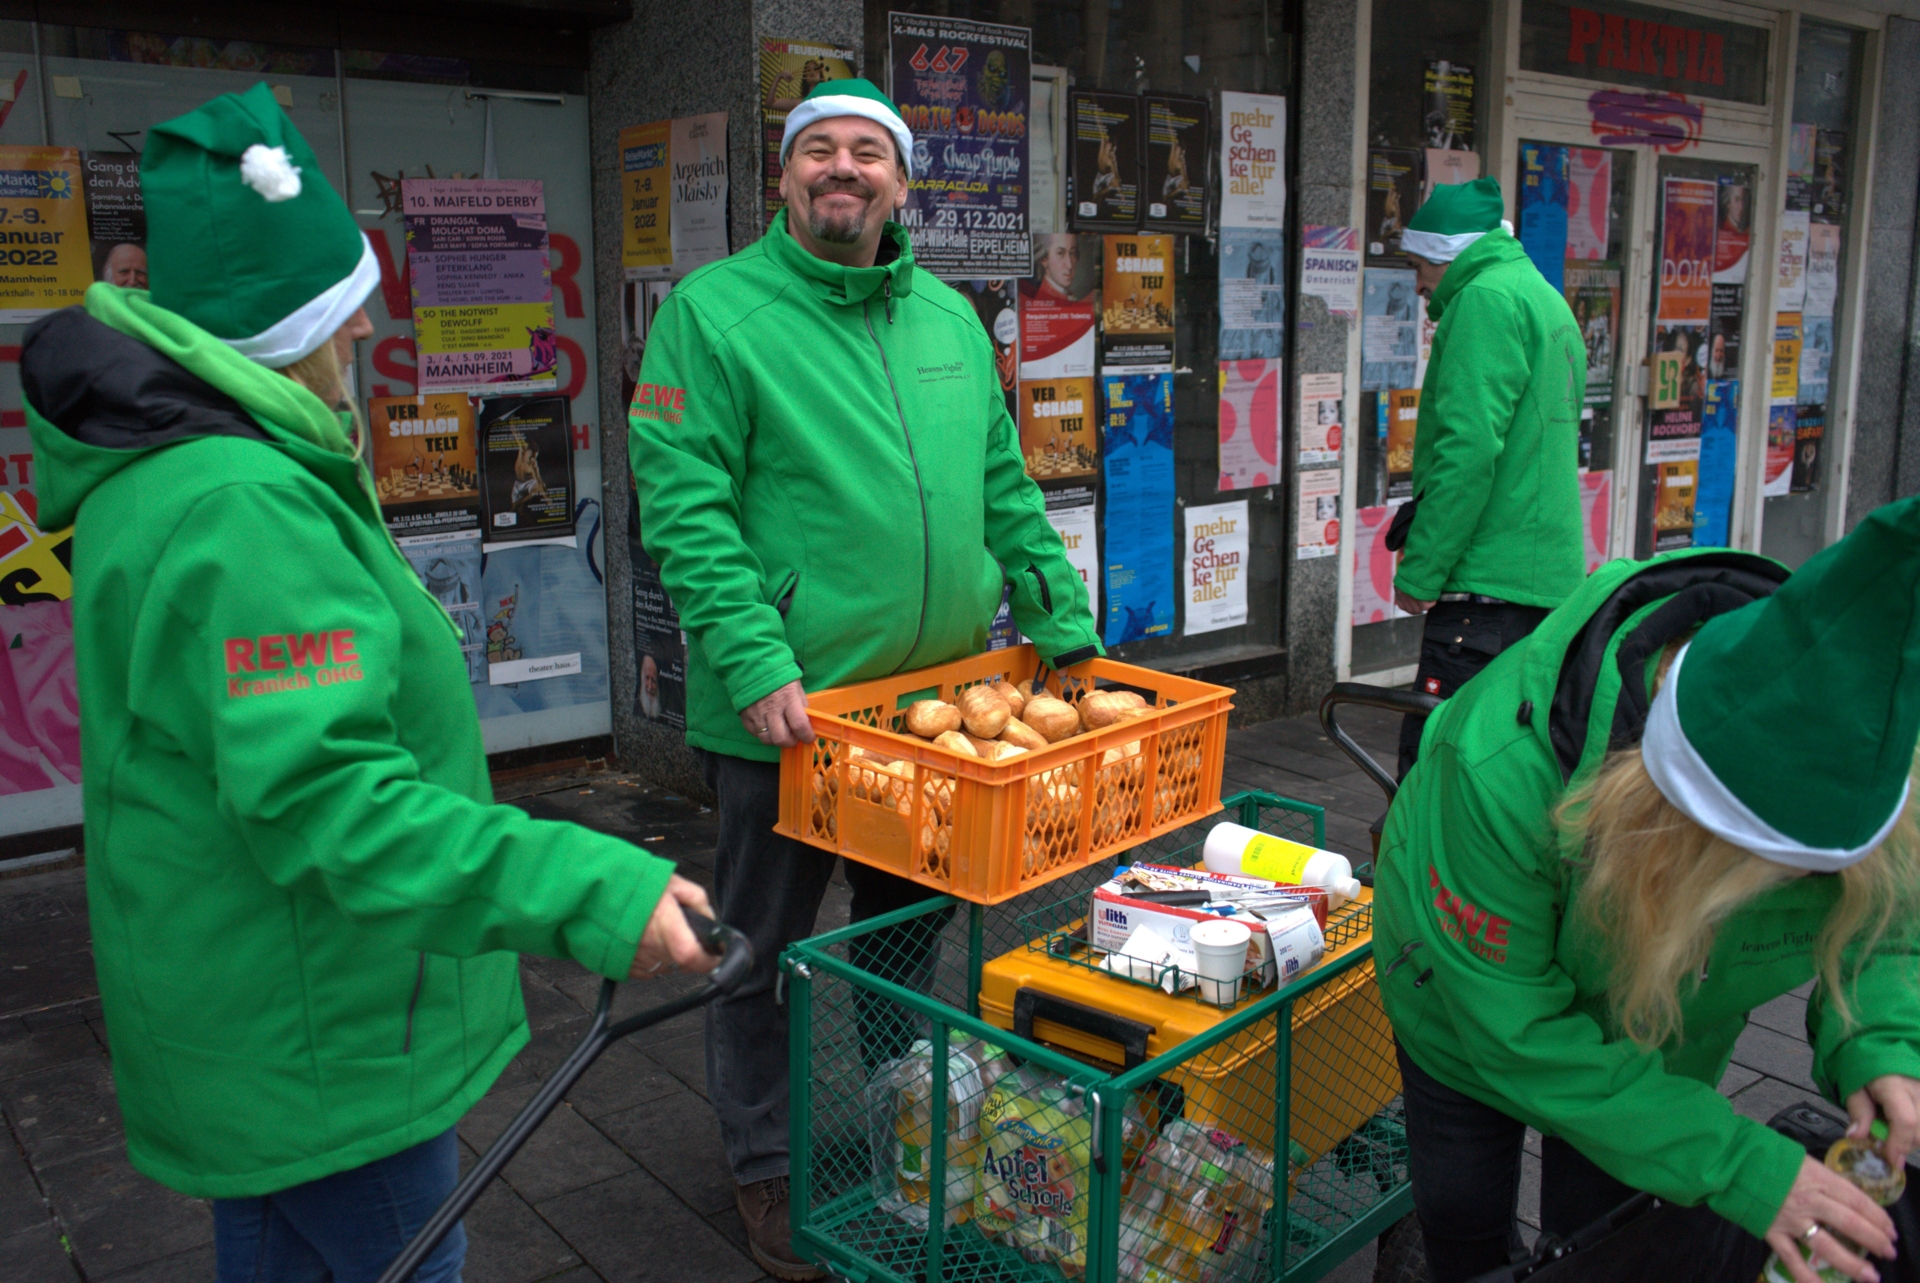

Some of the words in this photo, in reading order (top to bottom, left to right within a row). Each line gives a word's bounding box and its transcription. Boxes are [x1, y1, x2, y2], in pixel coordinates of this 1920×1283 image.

[893, 25, 935, 37] X-MAS
[939, 29, 1028, 49] ROCKFESTIVAL
[1568, 7, 1725, 86] PAKTIA
[909, 43, 970, 73] 667
[1229, 108, 1274, 129] mehr
[1230, 125, 1252, 143] Ge
[1229, 141, 1276, 162] schen
[87, 160, 123, 175] Gang
[673, 155, 725, 185] Argerich
[1229, 158, 1248, 178] ke
[1251, 160, 1275, 179] für
[89, 177, 113, 188] den
[907, 179, 989, 193] BARRACUDA
[1230, 177, 1265, 195] alle!
[410, 196, 430, 208] 10.
[433, 196, 492, 207] MAIFELD
[496, 196, 538, 207] DERBY
[677, 181, 721, 206] Maisky
[414, 217, 425, 226] FR
[430, 217, 479, 225] DRANGSAL
[634, 213, 657, 229] 2022
[901, 209, 929, 228] Mi.
[936, 210, 1024, 230] 29.12.2021
[431, 226, 475, 236] MOLCHAT
[477, 226, 506, 235] DOMA
[910, 228, 968, 247] dolf-Wild-Halle
[970, 230, 1021, 240] Schulstraße
[1021, 232, 1029, 240] 6
[970, 239, 1030, 255] EPPELHEIM
[1116, 243, 1137, 257] VER
[418, 255, 430, 264] SA
[435, 255, 468, 264] SOPHIE
[469, 254, 507, 263] HUNGER
[436, 263, 493, 273] EFTERKLANG
[1305, 257, 1358, 272] SPANISCH
[0, 276, 57, 284] Mannheim
[1307, 275, 1356, 285] Unterricht
[1662, 258, 1710, 287] DOTA
[1141, 275, 1165, 290] TELT
[70, 289, 84, 297] Uhr
[423, 310, 436, 318] SO
[440, 309, 457, 318] THE
[459, 308, 499, 317] NOTWIST
[440, 318, 483, 328] DEWOLFF
[427, 356, 436, 364] 3.
[444, 355, 454, 363] 4.
[463, 354, 472, 362] 5.
[473, 353, 489, 361] 09.
[491, 351, 512, 360] 2021
[426, 362, 513, 378] MANNHEIM
[1032, 386, 1056, 402] VER
[386, 404, 419, 421] VER
[630, 406, 660, 421] anich
[663, 410, 682, 425] OHG
[1033, 399, 1083, 419] SCHACH
[389, 417, 459, 437] SCHACH
[1060, 417, 1084, 433] TELT
[425, 435, 459, 453] TELT
[1193, 516, 1237, 539] mehr
[1194, 536, 1215, 554] Ge
[1192, 550, 1240, 570] schen
[1192, 568, 1213, 587] ke
[1214, 564, 1239, 585] für
[1192, 580, 1228, 604] alle!
[225, 630, 359, 674] REWE
[529, 663, 552, 674] theater
[554, 661, 571, 671] haus
[227, 671, 310, 699] Kranich
[316, 664, 363, 687] OHG
[1468, 937, 1507, 964] OHG
[983, 1146, 1047, 1184] Apfel
[1009, 1179, 1073, 1218] Schorle
